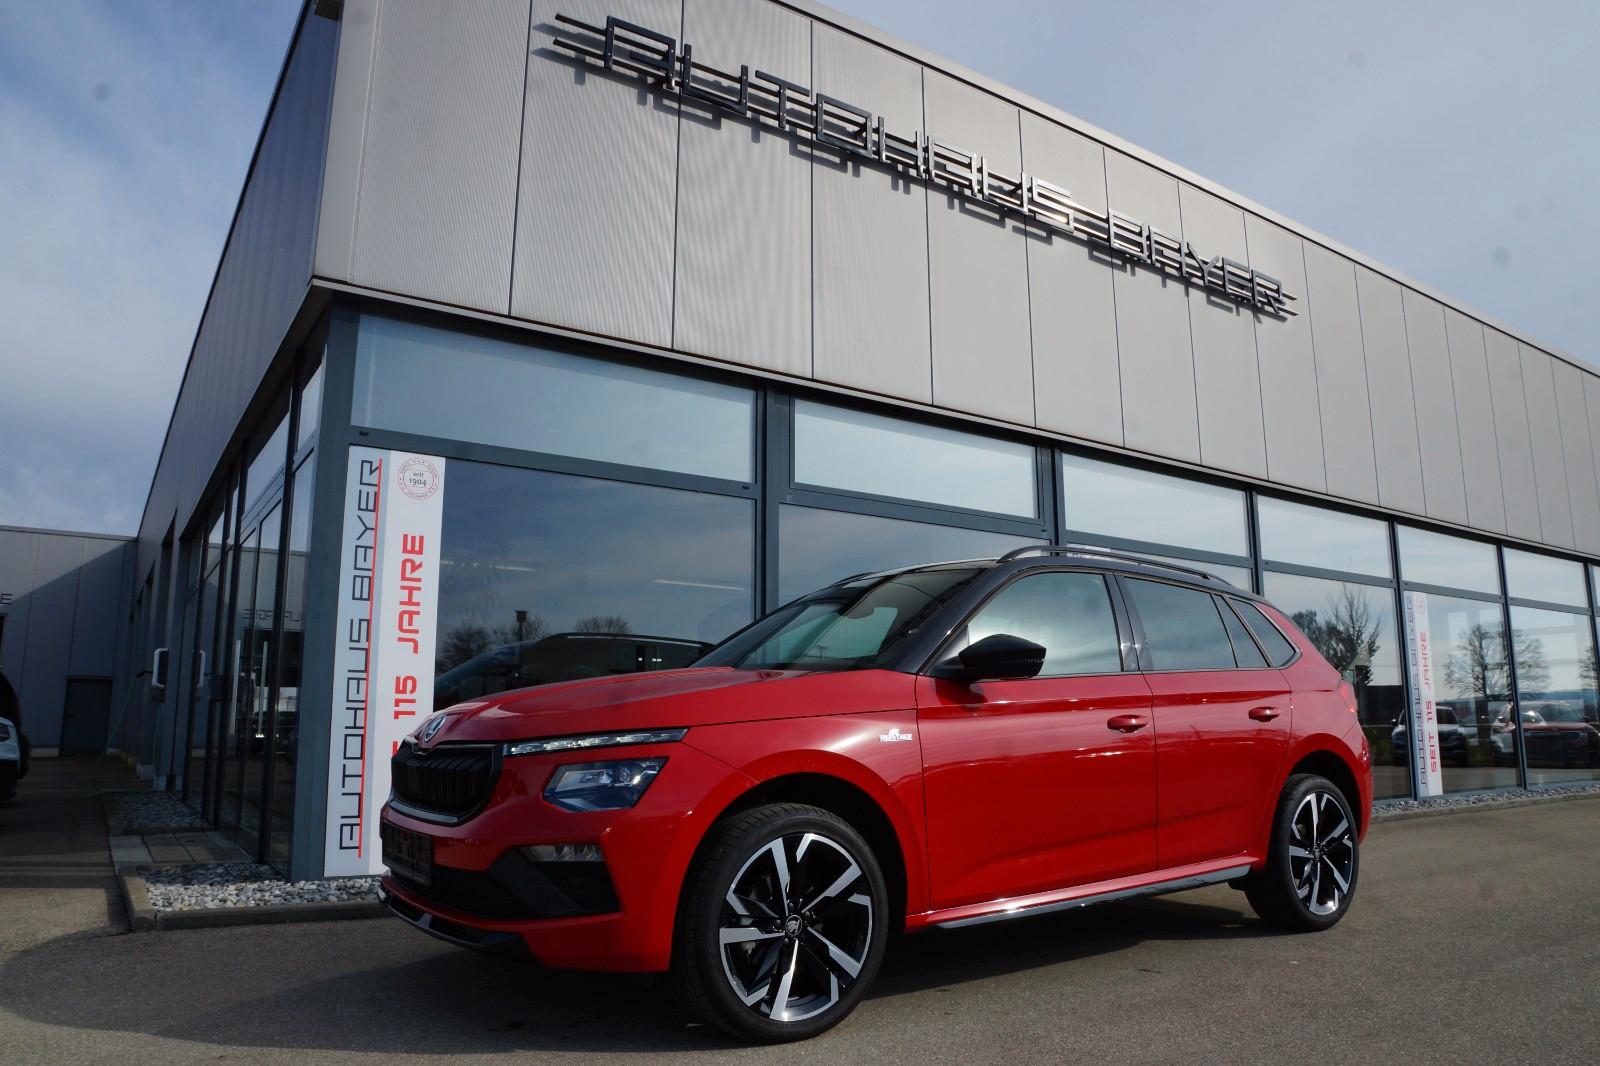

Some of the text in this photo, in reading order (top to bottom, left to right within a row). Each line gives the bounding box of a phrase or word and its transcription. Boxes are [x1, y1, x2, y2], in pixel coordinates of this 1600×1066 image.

[603, 15, 1284, 315] AUTOHAUS BAYER
[409, 477, 427, 487] 1904
[339, 459, 380, 850] AUTOHAUS BAYER
[393, 533, 425, 720] 115 JAHRE
[1420, 631, 1438, 773] SEIT 115 JAHRE
